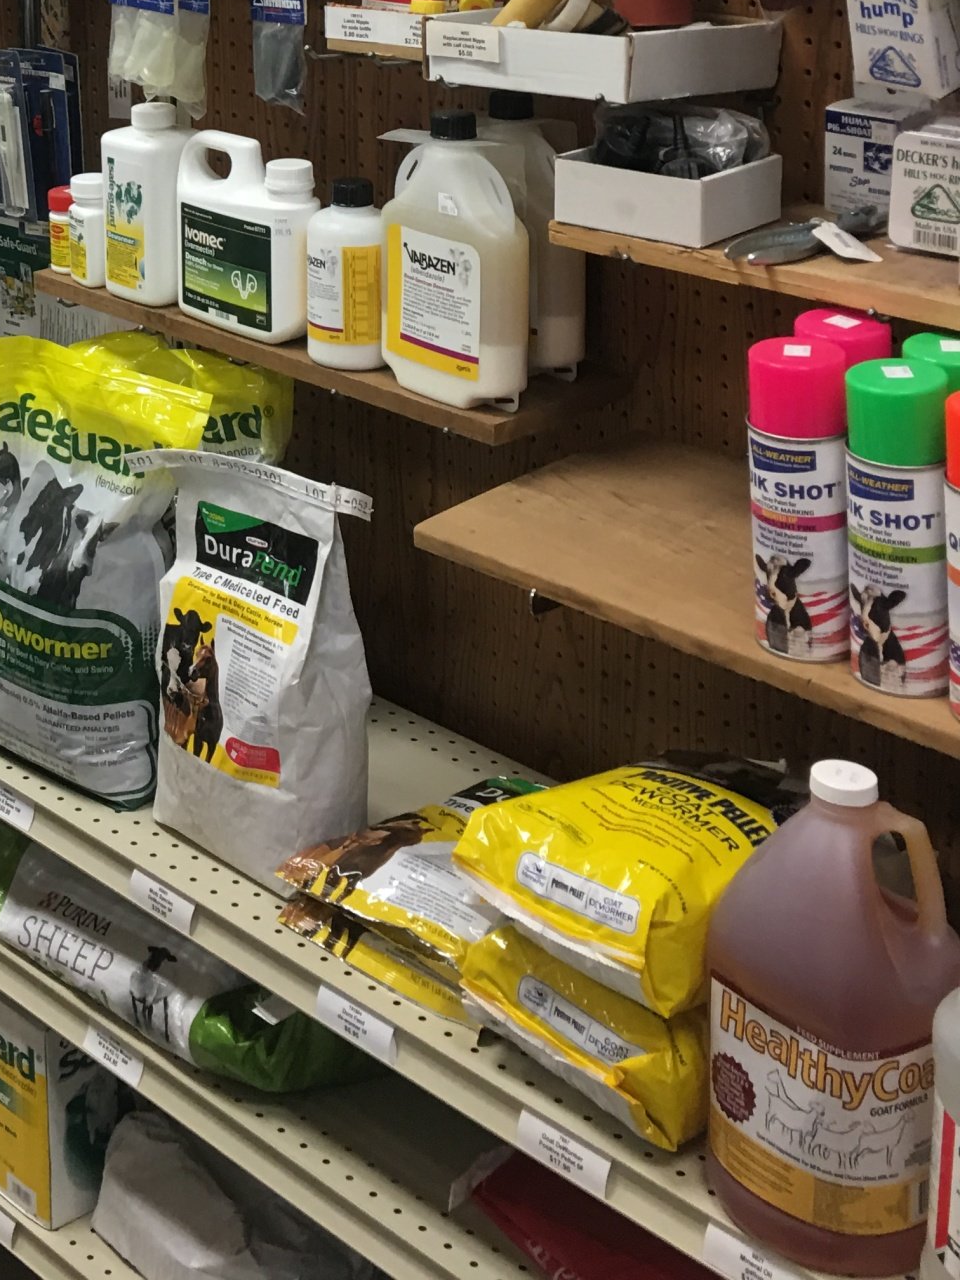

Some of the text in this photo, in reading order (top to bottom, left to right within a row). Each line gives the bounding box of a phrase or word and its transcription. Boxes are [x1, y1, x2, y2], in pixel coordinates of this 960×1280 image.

[860, 0, 914, 28] hump
[443, 35, 472, 43] Replacement
[855, 22, 925, 44] HILL'S RINGS
[827, 122, 840, 132] PIG
[832, 146, 843, 156] 24
[896, 148, 948, 169] DECKER'S
[904, 168, 928, 180] HILL'S
[185, 223, 224, 251] Ivomec
[915, 222, 957, 234] Made USA
[185, 239, 215, 257] (ivermectin)
[185, 251, 207, 266] Drench
[403, 242, 456, 276] VALBAZEN
[305, 484, 327, 500] LOT
[775, 481, 836, 500] SHOT
[780, 507, 815, 516] MARKING
[870, 509, 936, 530] SHOT
[875, 536, 911, 547] MARKING
[888, 554, 917, 564] GREEN
[192, 566, 300, 620] Type C Medicated Feed
[216, 592, 228, 604] Beef
[233, 598, 246, 612] Dairy
[264, 615, 284, 628] Horses
[240, 612, 259, 626] Animals
[42, 704, 135, 721] Alfalfa-Based Pellets
[632, 769, 719, 804] POSITIVE
[444, 797, 475, 813] Type
[656, 784, 722, 819] GOAT
[608, 779, 740, 853] DEWORMER
[631, 796, 702, 833] MEDICATED
[589, 897, 634, 923] DEWORMER
[603, 896, 623, 907] GOAT
[52, 895, 113, 937] PURINA
[17, 914, 115, 982] SHEEP
[604, 1037, 630, 1055] GOAT
[796, 1025, 880, 1061] FEED SUPPLEMENT
[870, 1102, 893, 1118] GOAT
[541, 1132, 555, 1145] Goat
[740, 1254, 762, 1271] Mineral
